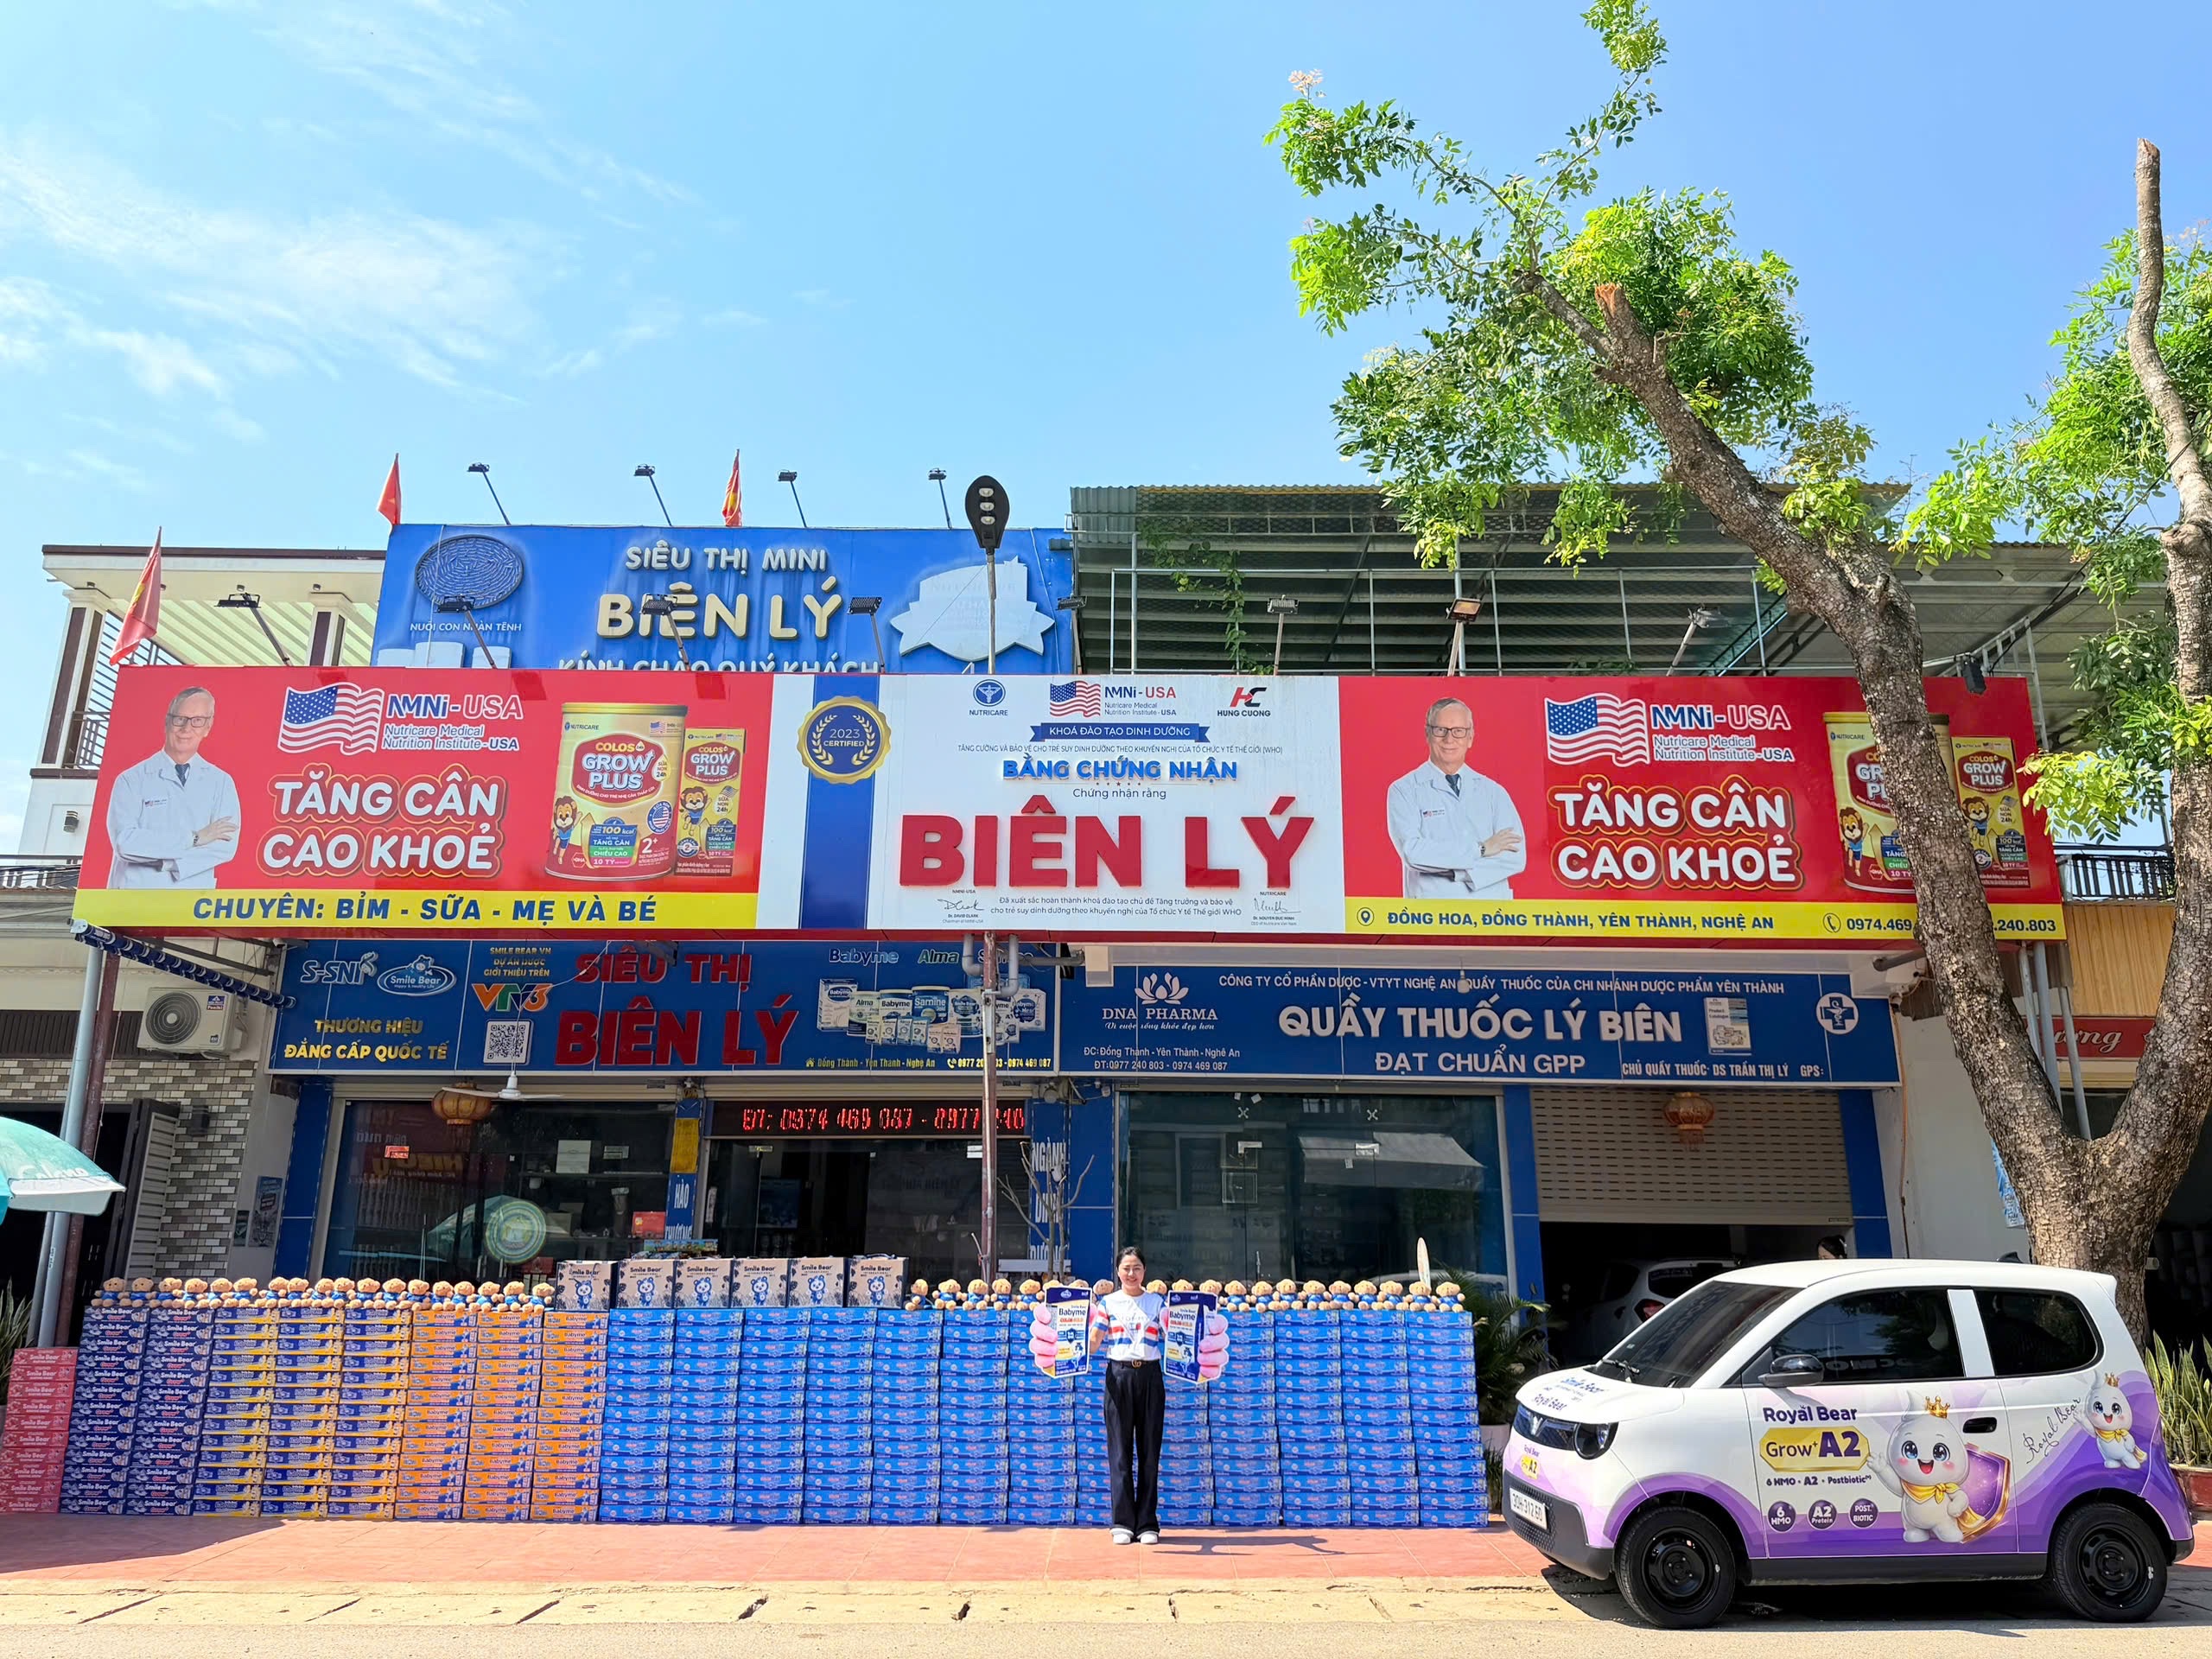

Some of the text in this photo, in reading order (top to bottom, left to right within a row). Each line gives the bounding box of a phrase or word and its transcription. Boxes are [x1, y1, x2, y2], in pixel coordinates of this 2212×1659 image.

[626, 539, 827, 576] SIÊU THỊ MINI
[596, 582, 749, 639] BIÊN
[769, 575, 843, 639] LÝ
[439, 622, 461, 632] CON
[385, 724, 485, 737] Nutricare Medical
[830, 728, 861, 739] 2023
[1050, 724, 1191, 737] KHOÁ ĐÀO TẠO DINH DƯỠNG
[383, 737, 431, 749] Nutrition
[582, 751, 653, 772] GROW
[1002, 752, 1237, 784] BẰNG CHỨNG NHẬN
[589, 772, 643, 790] PLUS
[275, 769, 499, 817] TĂNG CÂN
[1073, 787, 1166, 799] Chứng nhận rằng
[1554, 782, 1786, 828] TĂNG CÂN
[263, 823, 496, 869] CAO KHOẺ
[899, 794, 1314, 888] BIÊN LÝ
[1558, 835, 1796, 881] CAO KHOẺ
[193, 891, 657, 925] CHUYÊN: BỈM SỮA MẸ VÀ BÉ
[1388, 906, 1774, 931] ĐỒNG HOA, ĐỒNG THÀNH, YÊN THÀNH, NGHỆ AN
[829, 948, 899, 966] Babyme
[917, 949, 960, 964] Alma
[575, 945, 753, 993] SIÊU THỊ
[390, 974, 442, 985] Smile Bear
[1218, 974, 1253, 987] CÔNG
[1255, 976, 1272, 987] TY
[1274, 971, 1292, 988] CỔ
[1294, 972, 1326, 988] PHẦN
[1329, 976, 1362, 991] DƯỢC
[1370, 978, 1401, 988] VTYT
[1404, 976, 1436, 991] NGHỆ
[1440, 979, 1457, 988] AN
[1501, 975, 1542, 990] THUỐC
[1546, 976, 1571, 990] CỦA
[1573, 979, 1593, 990] CHI
[1597, 979, 1638, 992] NHÁNH
[1641, 981, 1675, 995] DƯỢC
[1678, 976, 1713, 992] PHẨM
[1716, 979, 1740, 993] YÊN
[1744, 980, 1784, 994] THÀNH
[472, 983, 553, 1012] VTV3
[1103, 1008, 1218, 1020] DNA PHARMA
[1279, 992, 1386, 1038] QUẦY
[1397, 993, 1534, 1039] THUỐC
[1544, 997, 1586, 1040] LÝ
[1599, 1002, 1682, 1042] BIÊN
[315, 1017, 423, 1037] THƯƠNG HIỆU
[554, 994, 800, 1065] BIÊN LÝ
[284, 1038, 450, 1062] ĐẲNG CẤP QUỐC TẾ
[1156, 1046, 1171, 1057] Yên
[1173, 1046, 1199, 1057] Thành
[1228, 1048, 1241, 1057] An
[1376, 1043, 1586, 1075] ĐẠT CHUẨN GPP
[1148, 1061, 1164, 1070] 803
[1173, 1061, 1192, 1071] 0974
[1195, 1061, 1211, 1071] 469
[1212, 1061, 1228, 1071] 087
[1622, 1058, 1642, 1076] CHỦ
[1713, 1064, 1726, 1076] DS
[1730, 1060, 1757, 1077] TRẦN
[1758, 1064, 1774, 1078] THỊ
[1777, 1062, 1789, 1077] LÝ
[1763, 1405, 1858, 1424] Royal Bear
[1818, 1431, 1861, 1458] A2
[1774, 1478, 1796, 1486] HMO
[1803, 1476, 1818, 1485] A2
[1770, 1516, 1791, 1525] HMO
[1777, 1506, 1785, 1517] 6
[1813, 1505, 1832, 1517] A2
